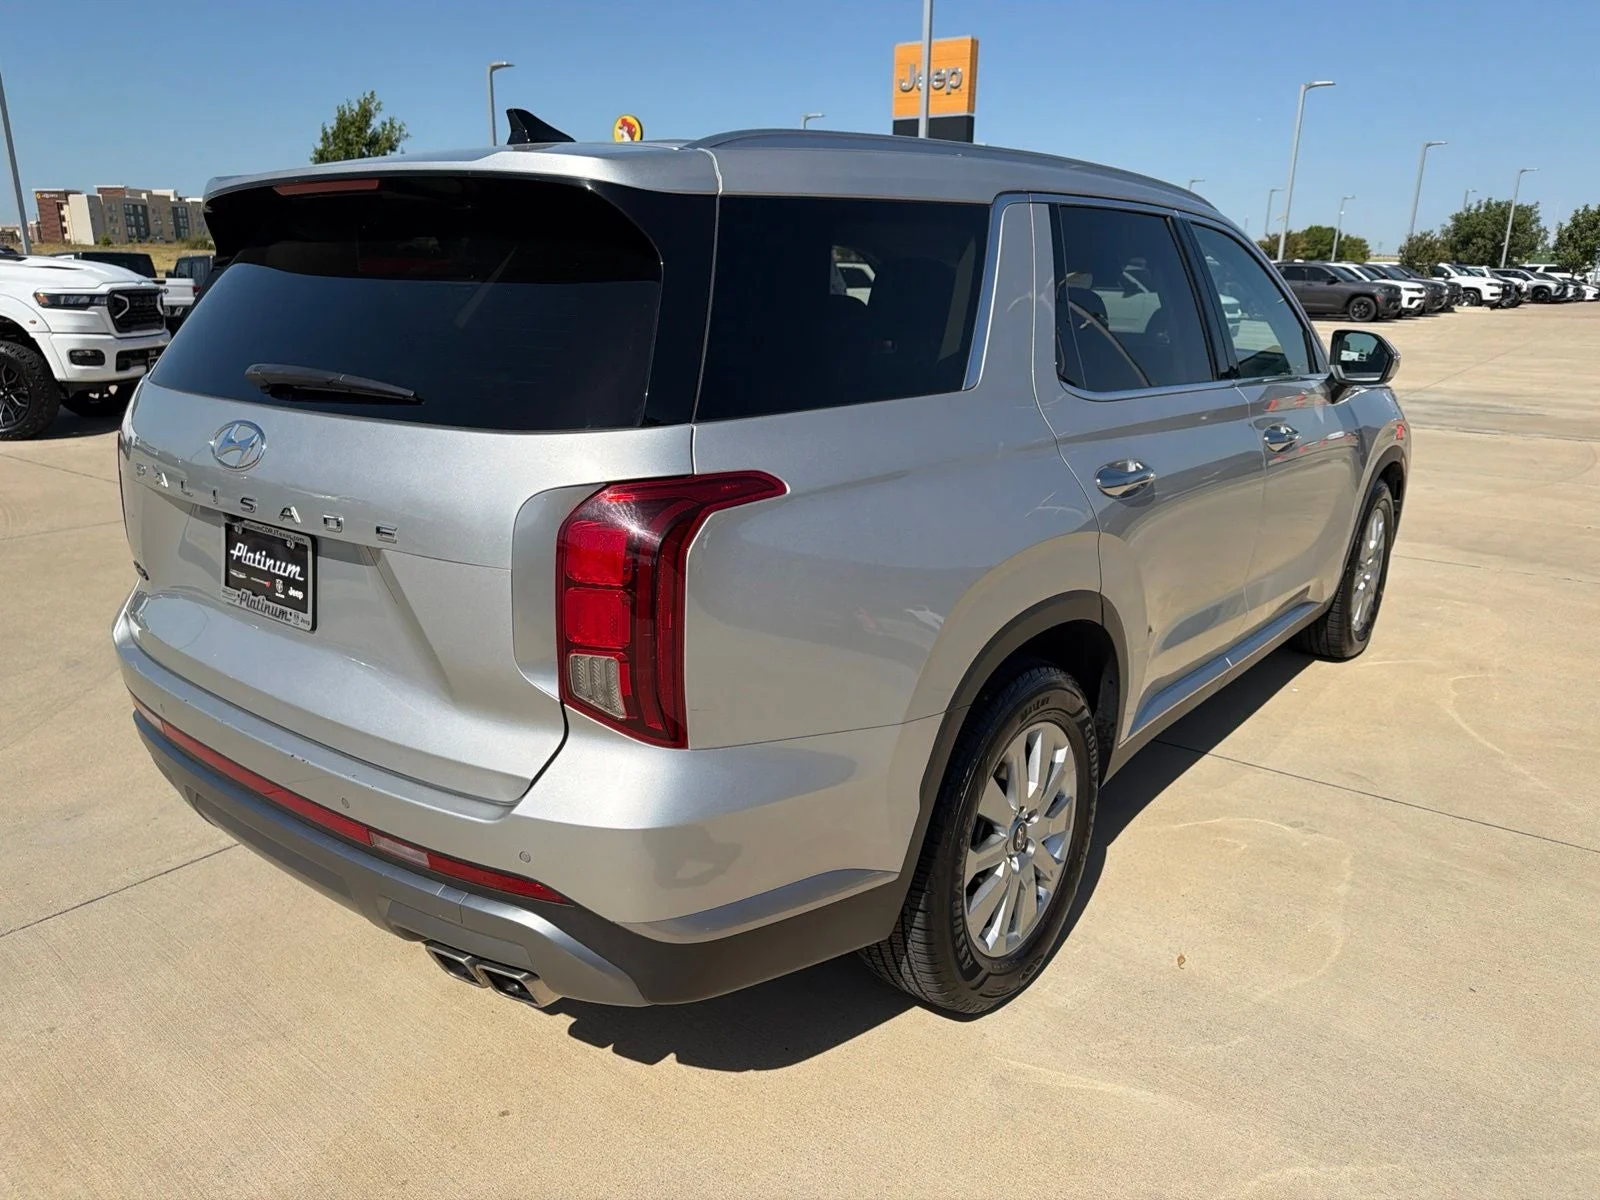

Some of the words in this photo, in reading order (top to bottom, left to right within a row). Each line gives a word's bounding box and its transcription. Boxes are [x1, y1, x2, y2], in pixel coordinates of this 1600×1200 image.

[136, 462, 399, 543] PALISADE
[230, 542, 305, 581] Platinum
[240, 591, 292, 622] Platinum
